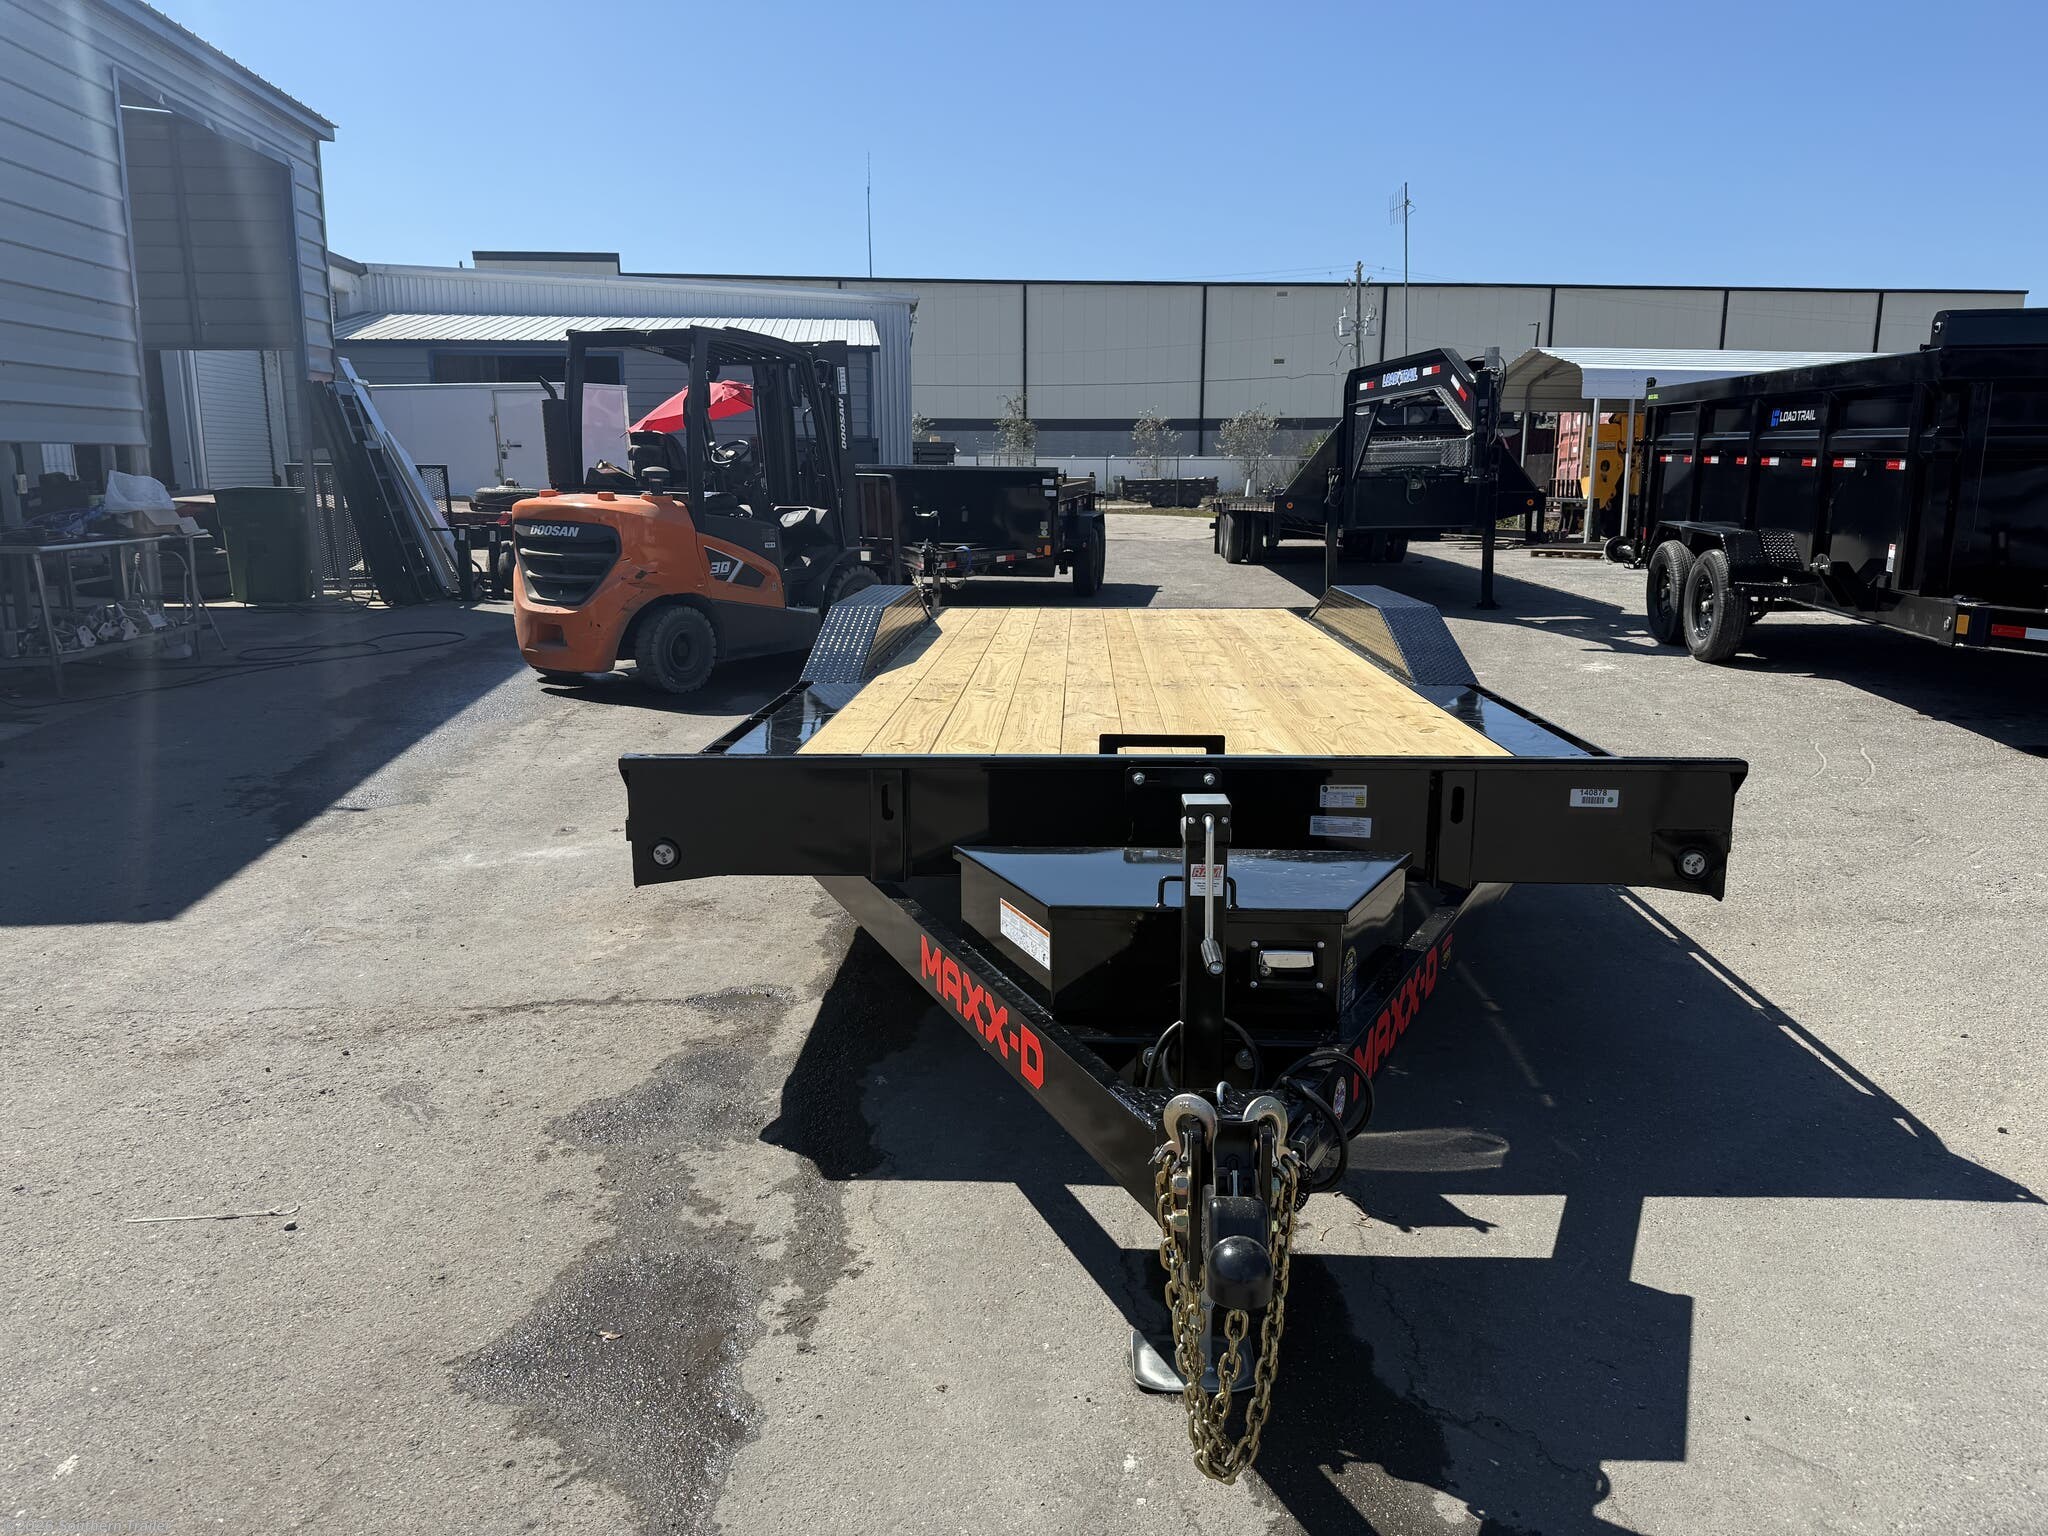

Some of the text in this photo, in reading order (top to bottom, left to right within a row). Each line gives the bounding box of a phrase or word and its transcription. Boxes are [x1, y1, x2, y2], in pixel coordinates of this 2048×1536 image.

[838, 398, 847, 450] DOOSAN
[530, 524, 580, 538] DOOSAN
[709, 561, 731, 577] 30
[1580, 788, 1608, 796] 140878
[921, 934, 1044, 1090] MAXX-D
[1353, 946, 1438, 1102] MAXX-D
